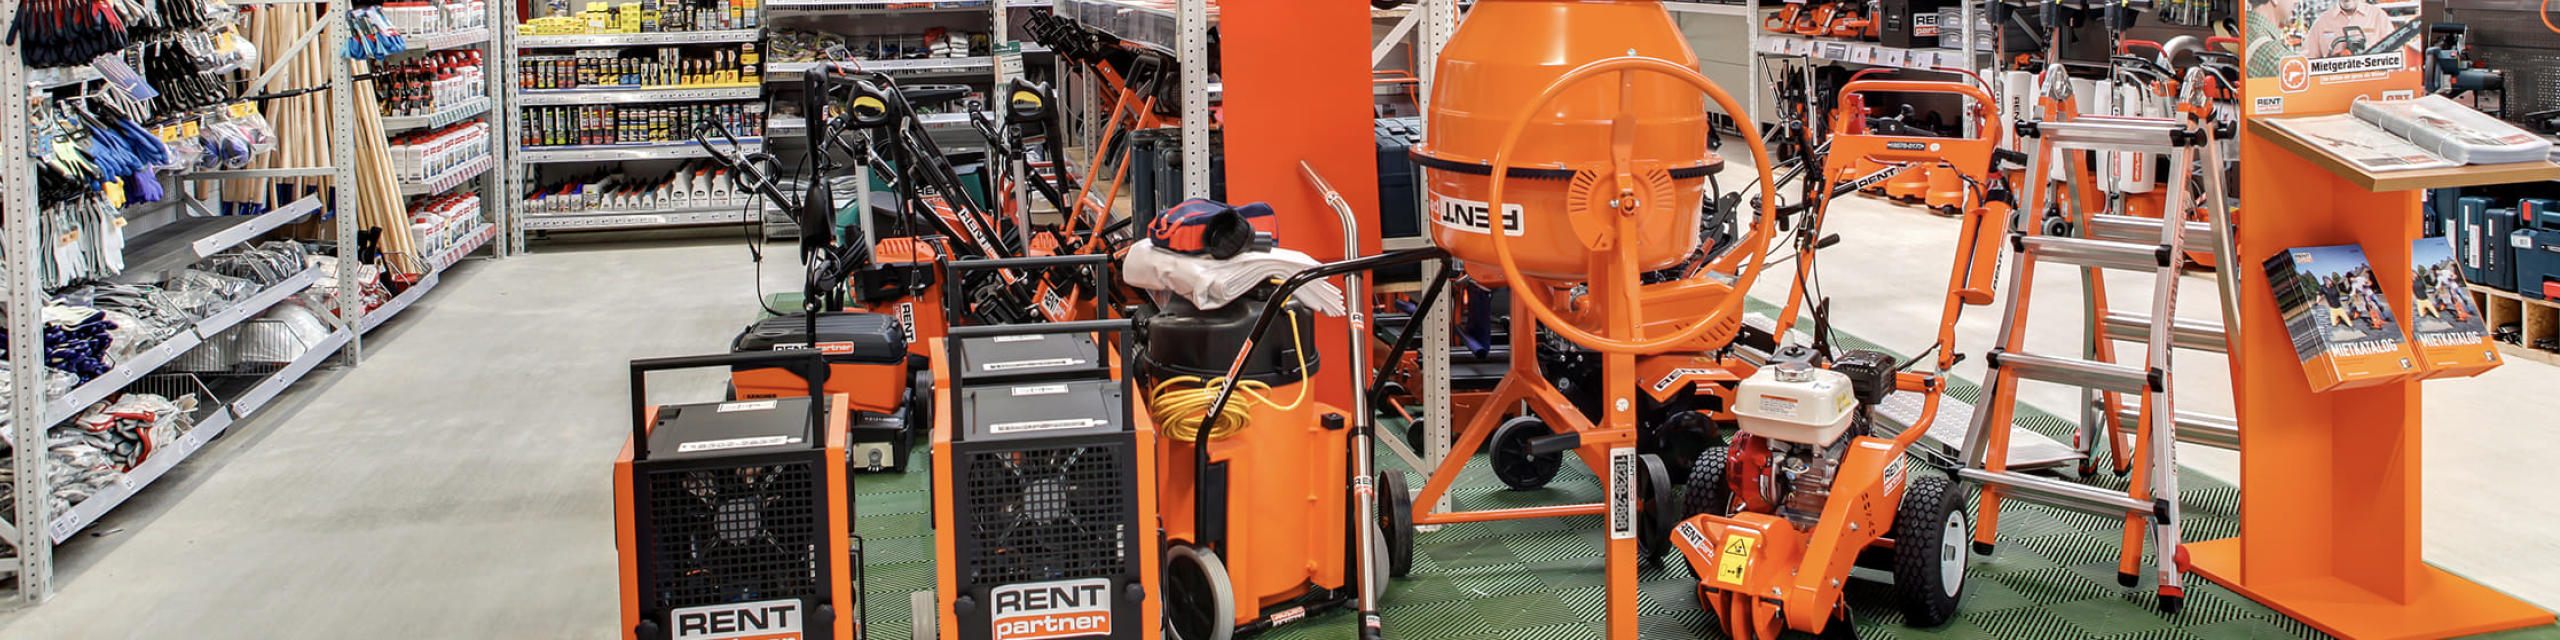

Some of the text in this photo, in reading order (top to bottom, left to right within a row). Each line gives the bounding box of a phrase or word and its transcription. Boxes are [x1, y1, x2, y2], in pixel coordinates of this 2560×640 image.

[2311, 56, 2400, 72] Mietgeräte-Service
[902, 304, 914, 342] RENT
[2331, 339, 2398, 357] MIETKATALOG
[2420, 332, 2482, 347] MIETKATALOG
[996, 584, 1105, 615] RENT
[679, 605, 795, 636] RENT
[997, 615, 1106, 640] partner
